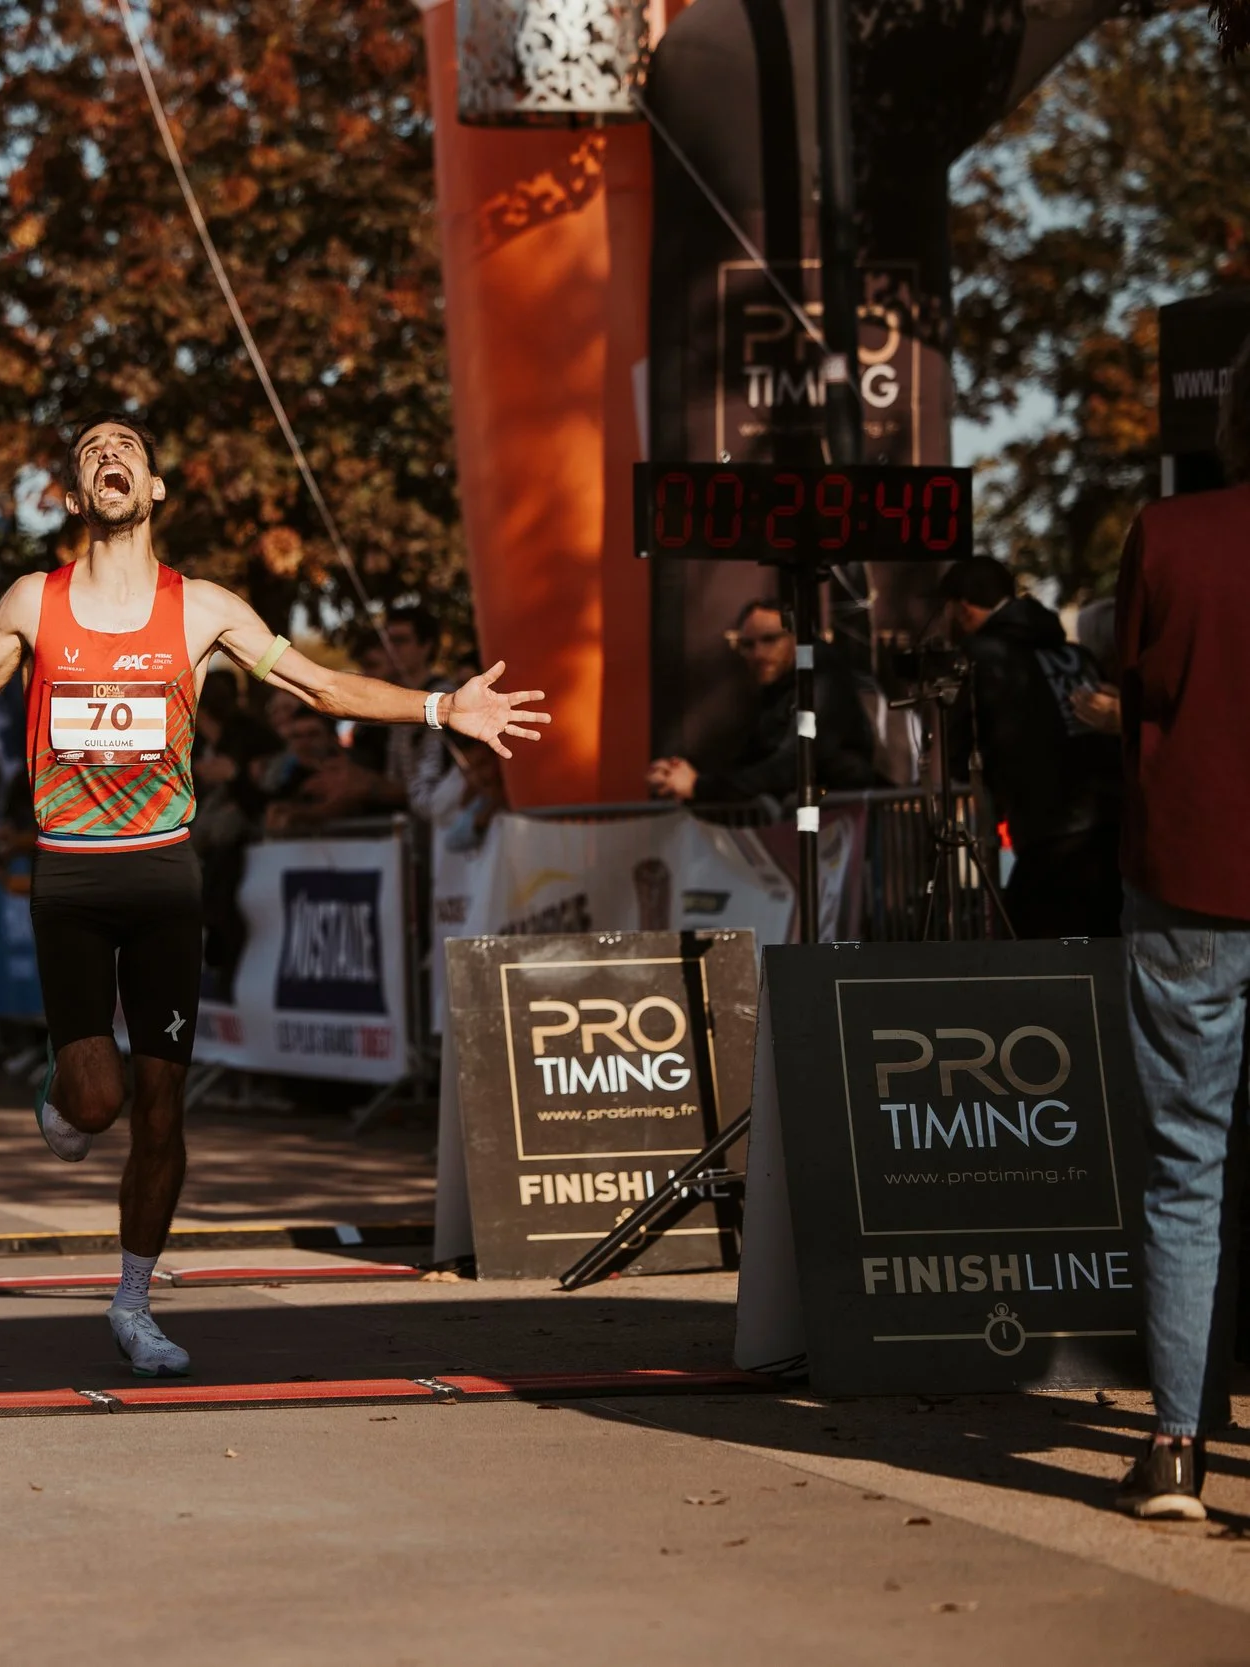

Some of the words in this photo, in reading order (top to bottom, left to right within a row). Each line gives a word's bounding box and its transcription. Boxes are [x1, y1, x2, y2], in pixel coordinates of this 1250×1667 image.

[743, 363, 900, 408] TIMIG
[655, 472, 960, 550] 00:29:40
[112, 653, 152, 671] PAC
[87, 702, 133, 731] 70
[140, 753, 161, 761] HOKA
[528, 996, 687, 1056] PRO
[534, 1052, 691, 1096] TIMING
[871, 1025, 1072, 1098] PRO
[537, 1103, 697, 1122] www.protiming.fr
[880, 1099, 1077, 1150] TIMING
[883, 1166, 1088, 1186] www.protiming.fr
[861, 1251, 1133, 1294] FINISHLINE
